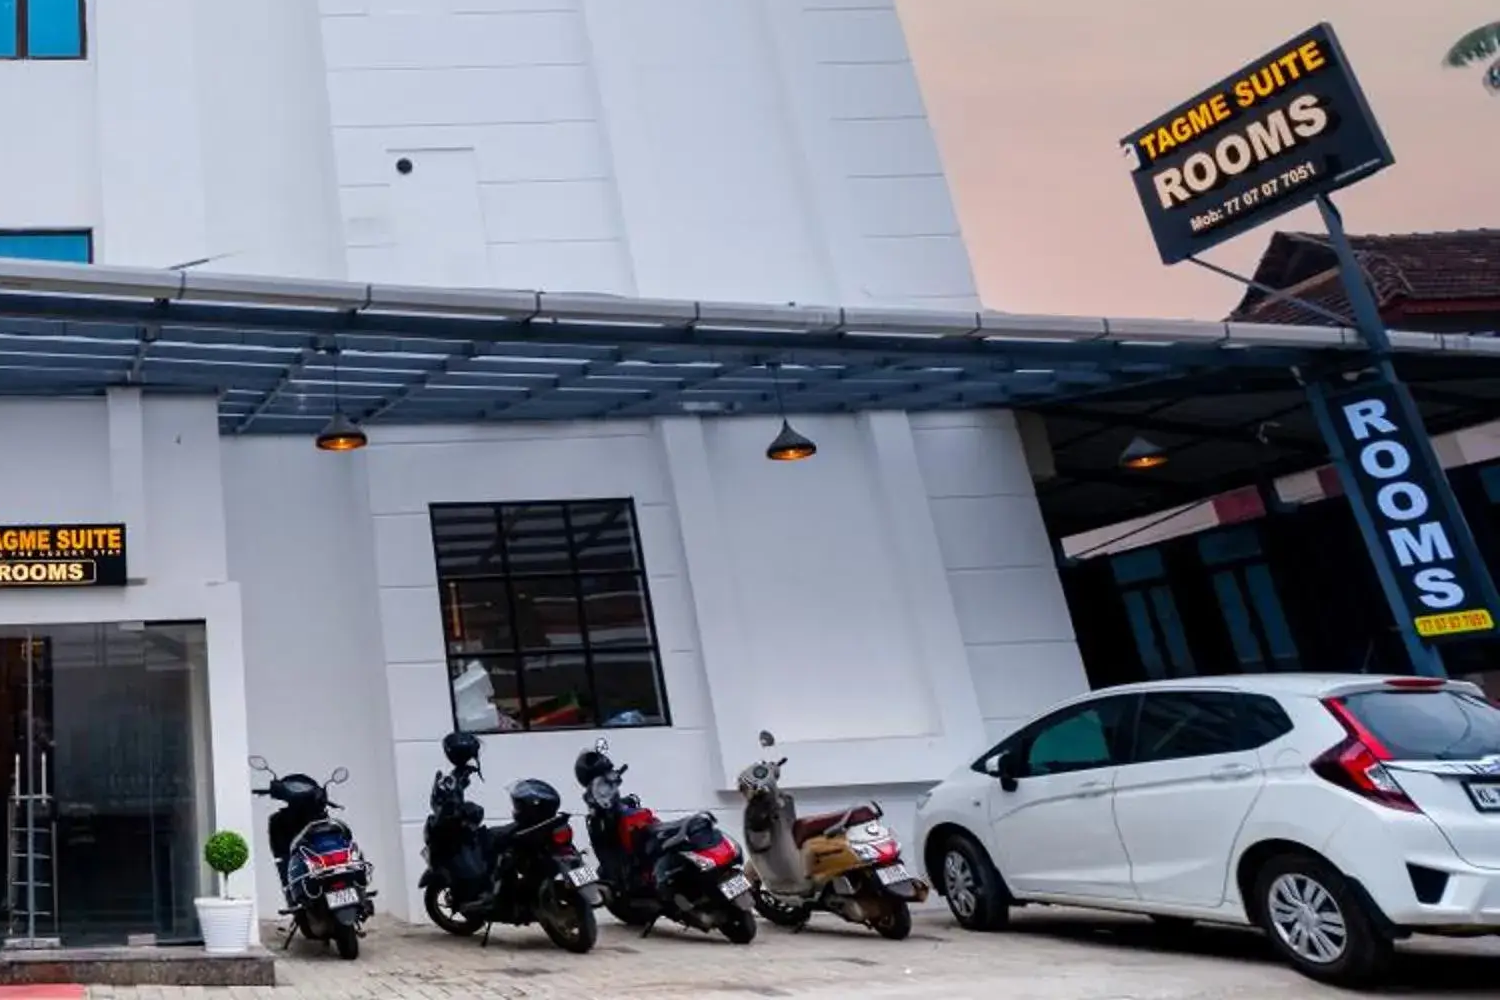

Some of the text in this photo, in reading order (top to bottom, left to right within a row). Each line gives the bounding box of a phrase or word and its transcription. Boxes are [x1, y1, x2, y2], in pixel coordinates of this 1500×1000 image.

[1139, 94, 1231, 159] TAGME
[1234, 40, 1325, 107] SUITE
[1152, 94, 1328, 209] ROOMS
[1189, 208, 1224, 232] Mob:
[1223, 197, 1240, 214] 77
[1242, 187, 1259, 206] 07
[1261, 178, 1278, 197] 07
[1280, 161, 1316, 187] 7051
[56, 528, 121, 550] SUITE
[1343, 399, 1465, 609] ROOMS
